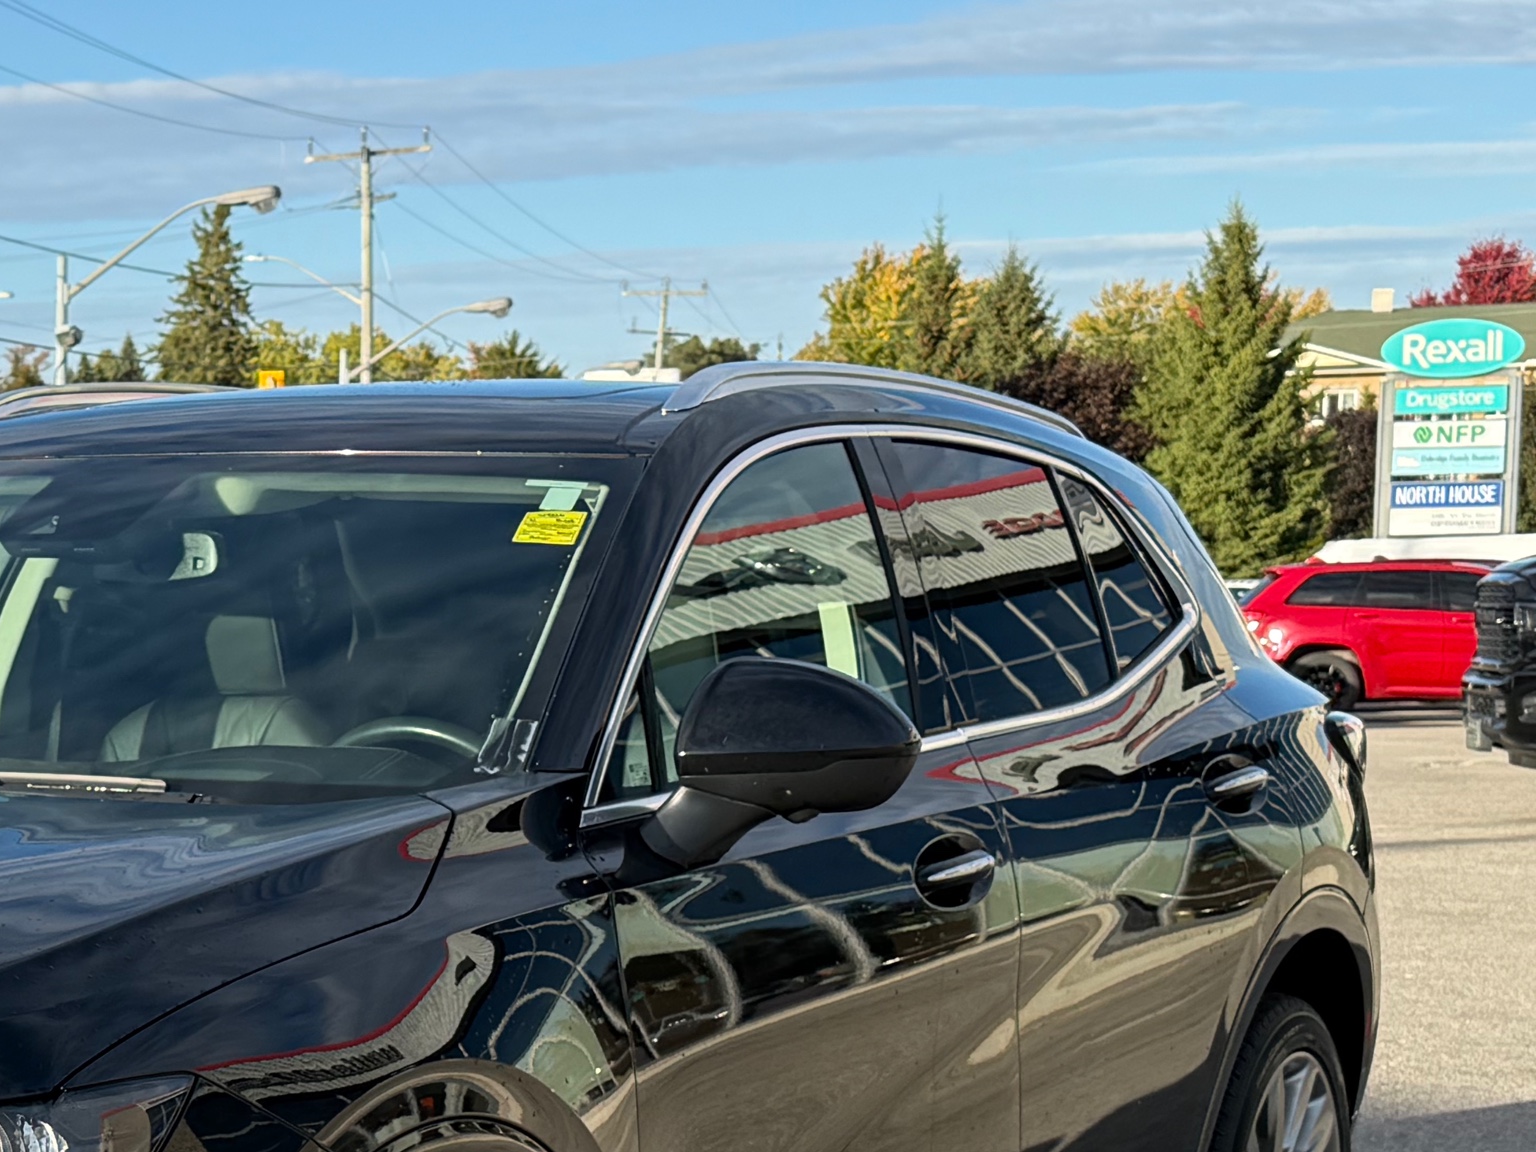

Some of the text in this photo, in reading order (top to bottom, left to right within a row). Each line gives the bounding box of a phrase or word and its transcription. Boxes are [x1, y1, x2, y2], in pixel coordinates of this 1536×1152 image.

[1402, 329, 1504, 369] Rexall
[1405, 389, 1495, 411] Drugstore
[1436, 425, 1486, 443] NFP
[1395, 484, 1497, 505] NORTH HOUSE
